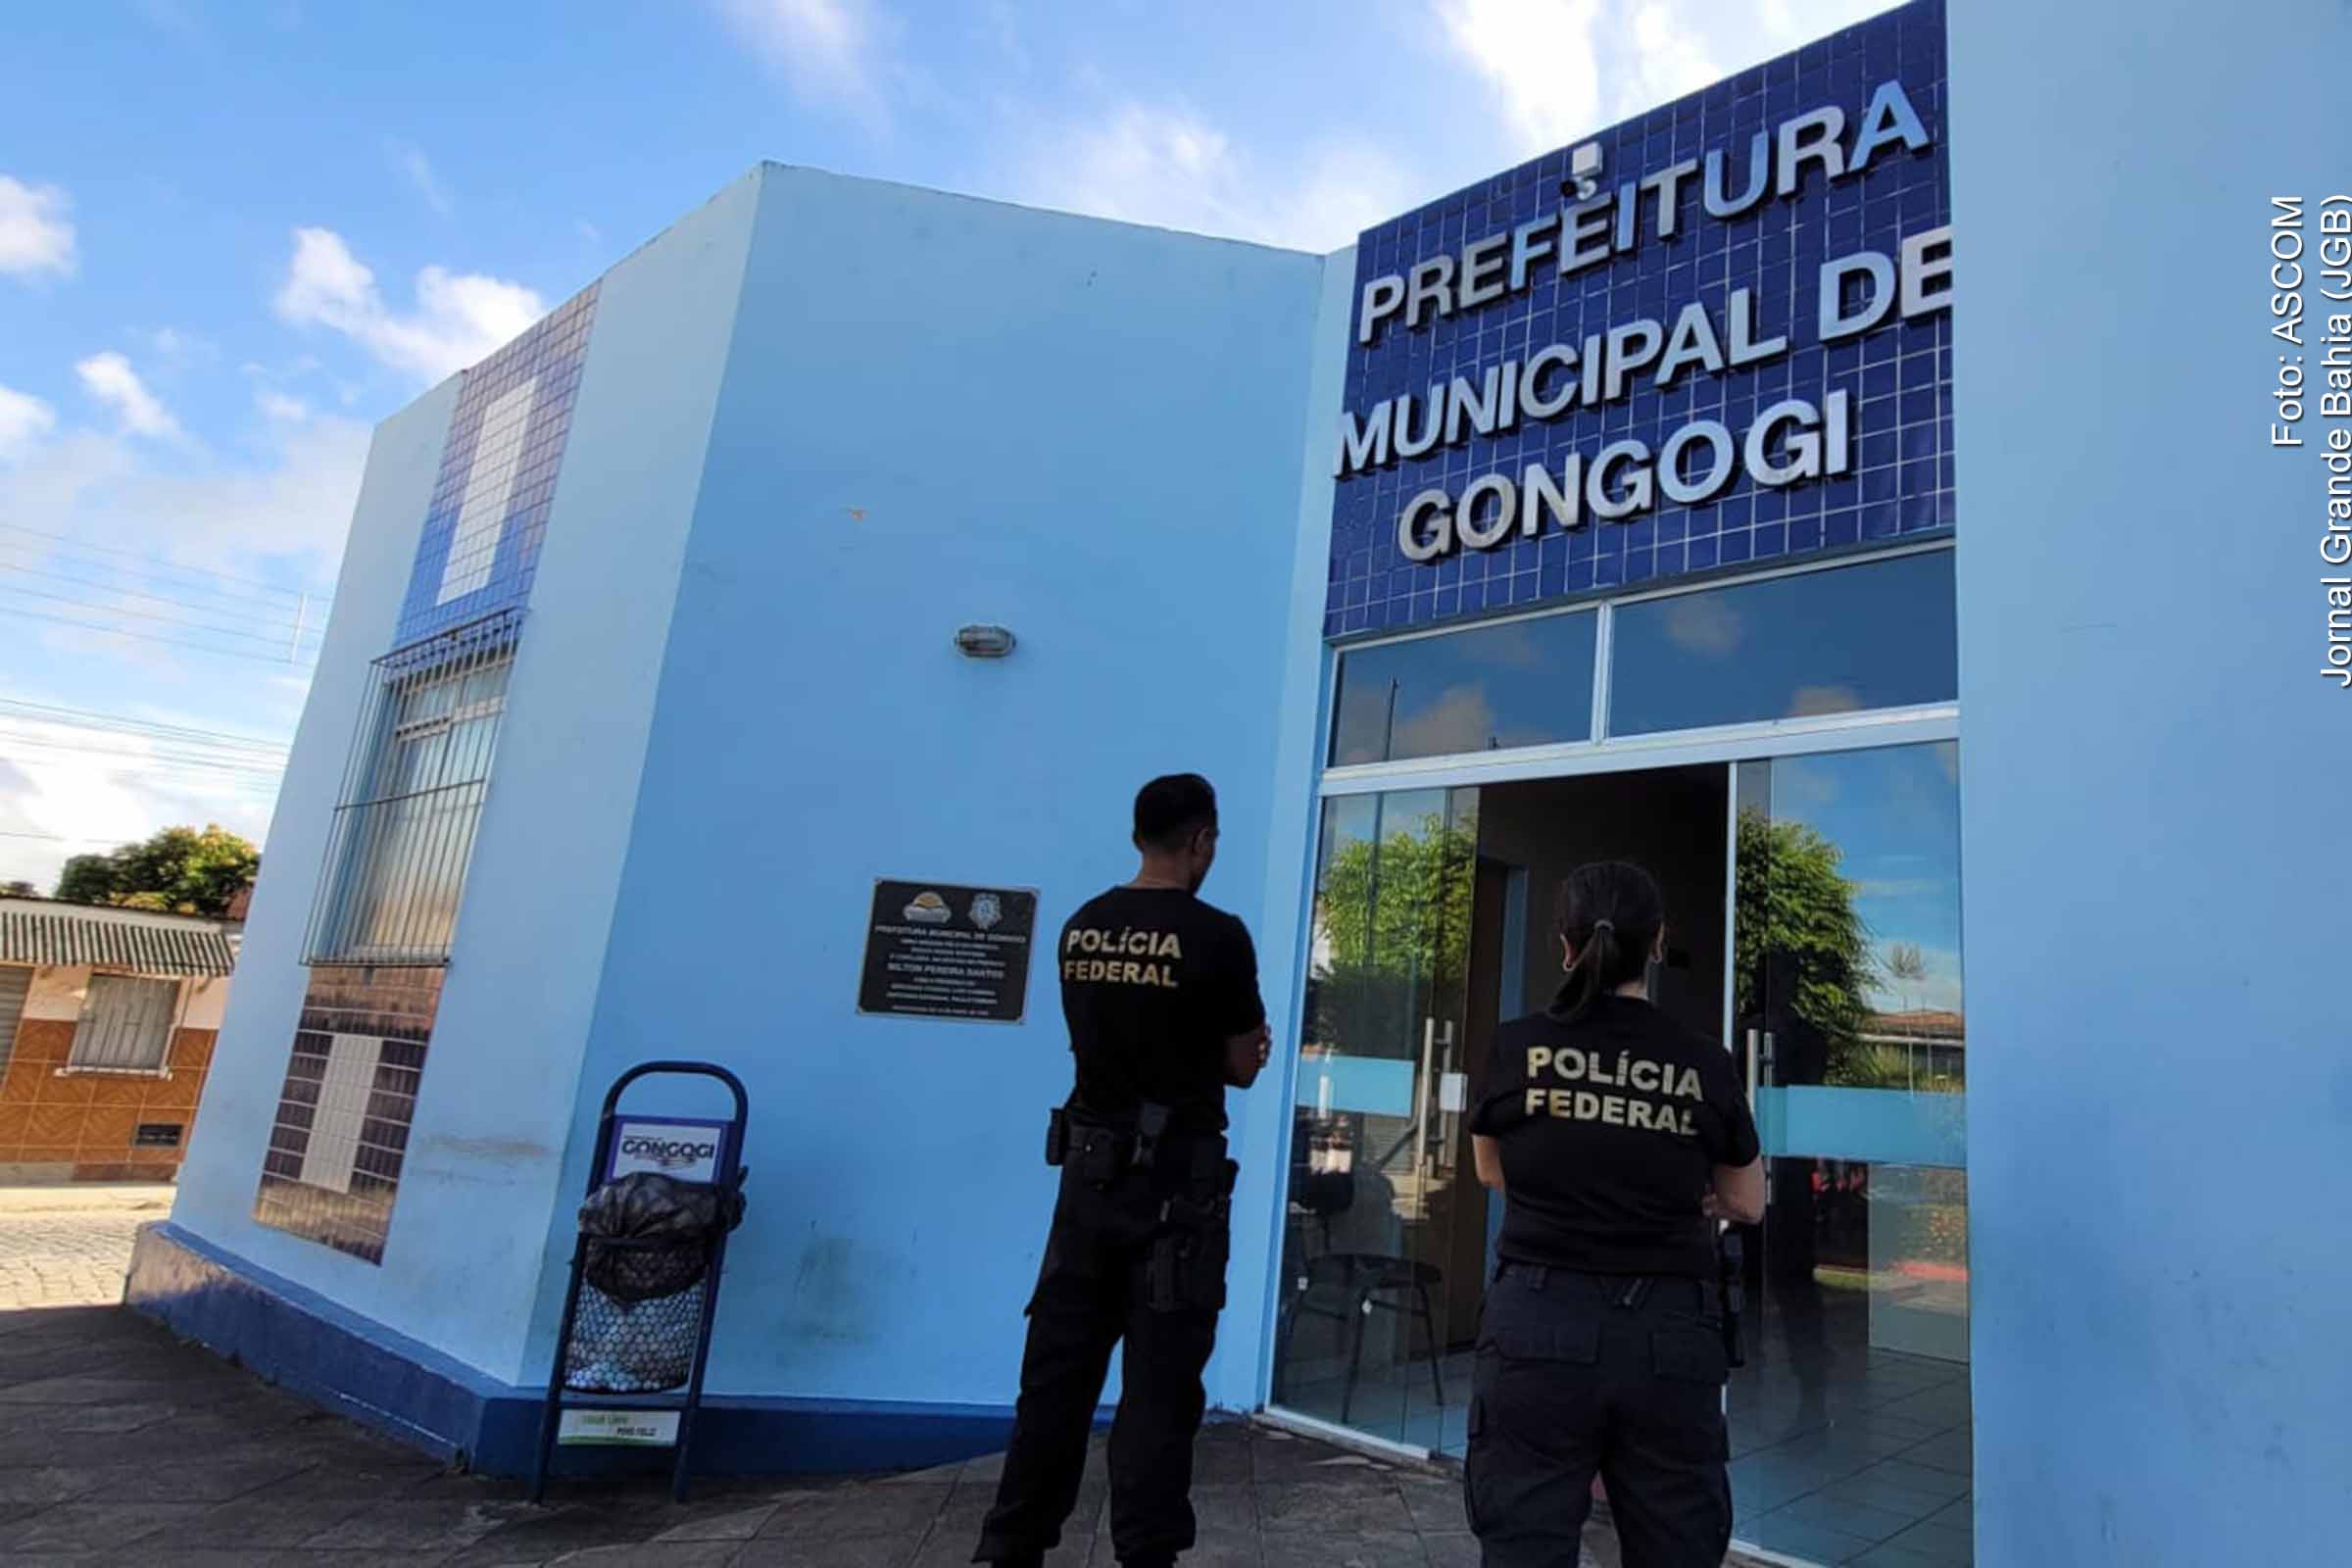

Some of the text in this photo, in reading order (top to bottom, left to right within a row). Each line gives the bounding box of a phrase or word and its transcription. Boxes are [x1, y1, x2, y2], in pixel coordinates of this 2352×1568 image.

[1359, 80, 1930, 344] PREFEITURA
[1334, 224, 1953, 479] MUNICIPAL DE
[1397, 388, 1848, 562] GONGOGI
[1066, 926, 1182, 958] POLÍCIA
[1064, 959, 1178, 988] FEDERAL
[1527, 1046, 1703, 1102] POLÍCIA
[1525, 1088, 1697, 1136] FEDERAL
[622, 1140, 714, 1159] GONGOGI
